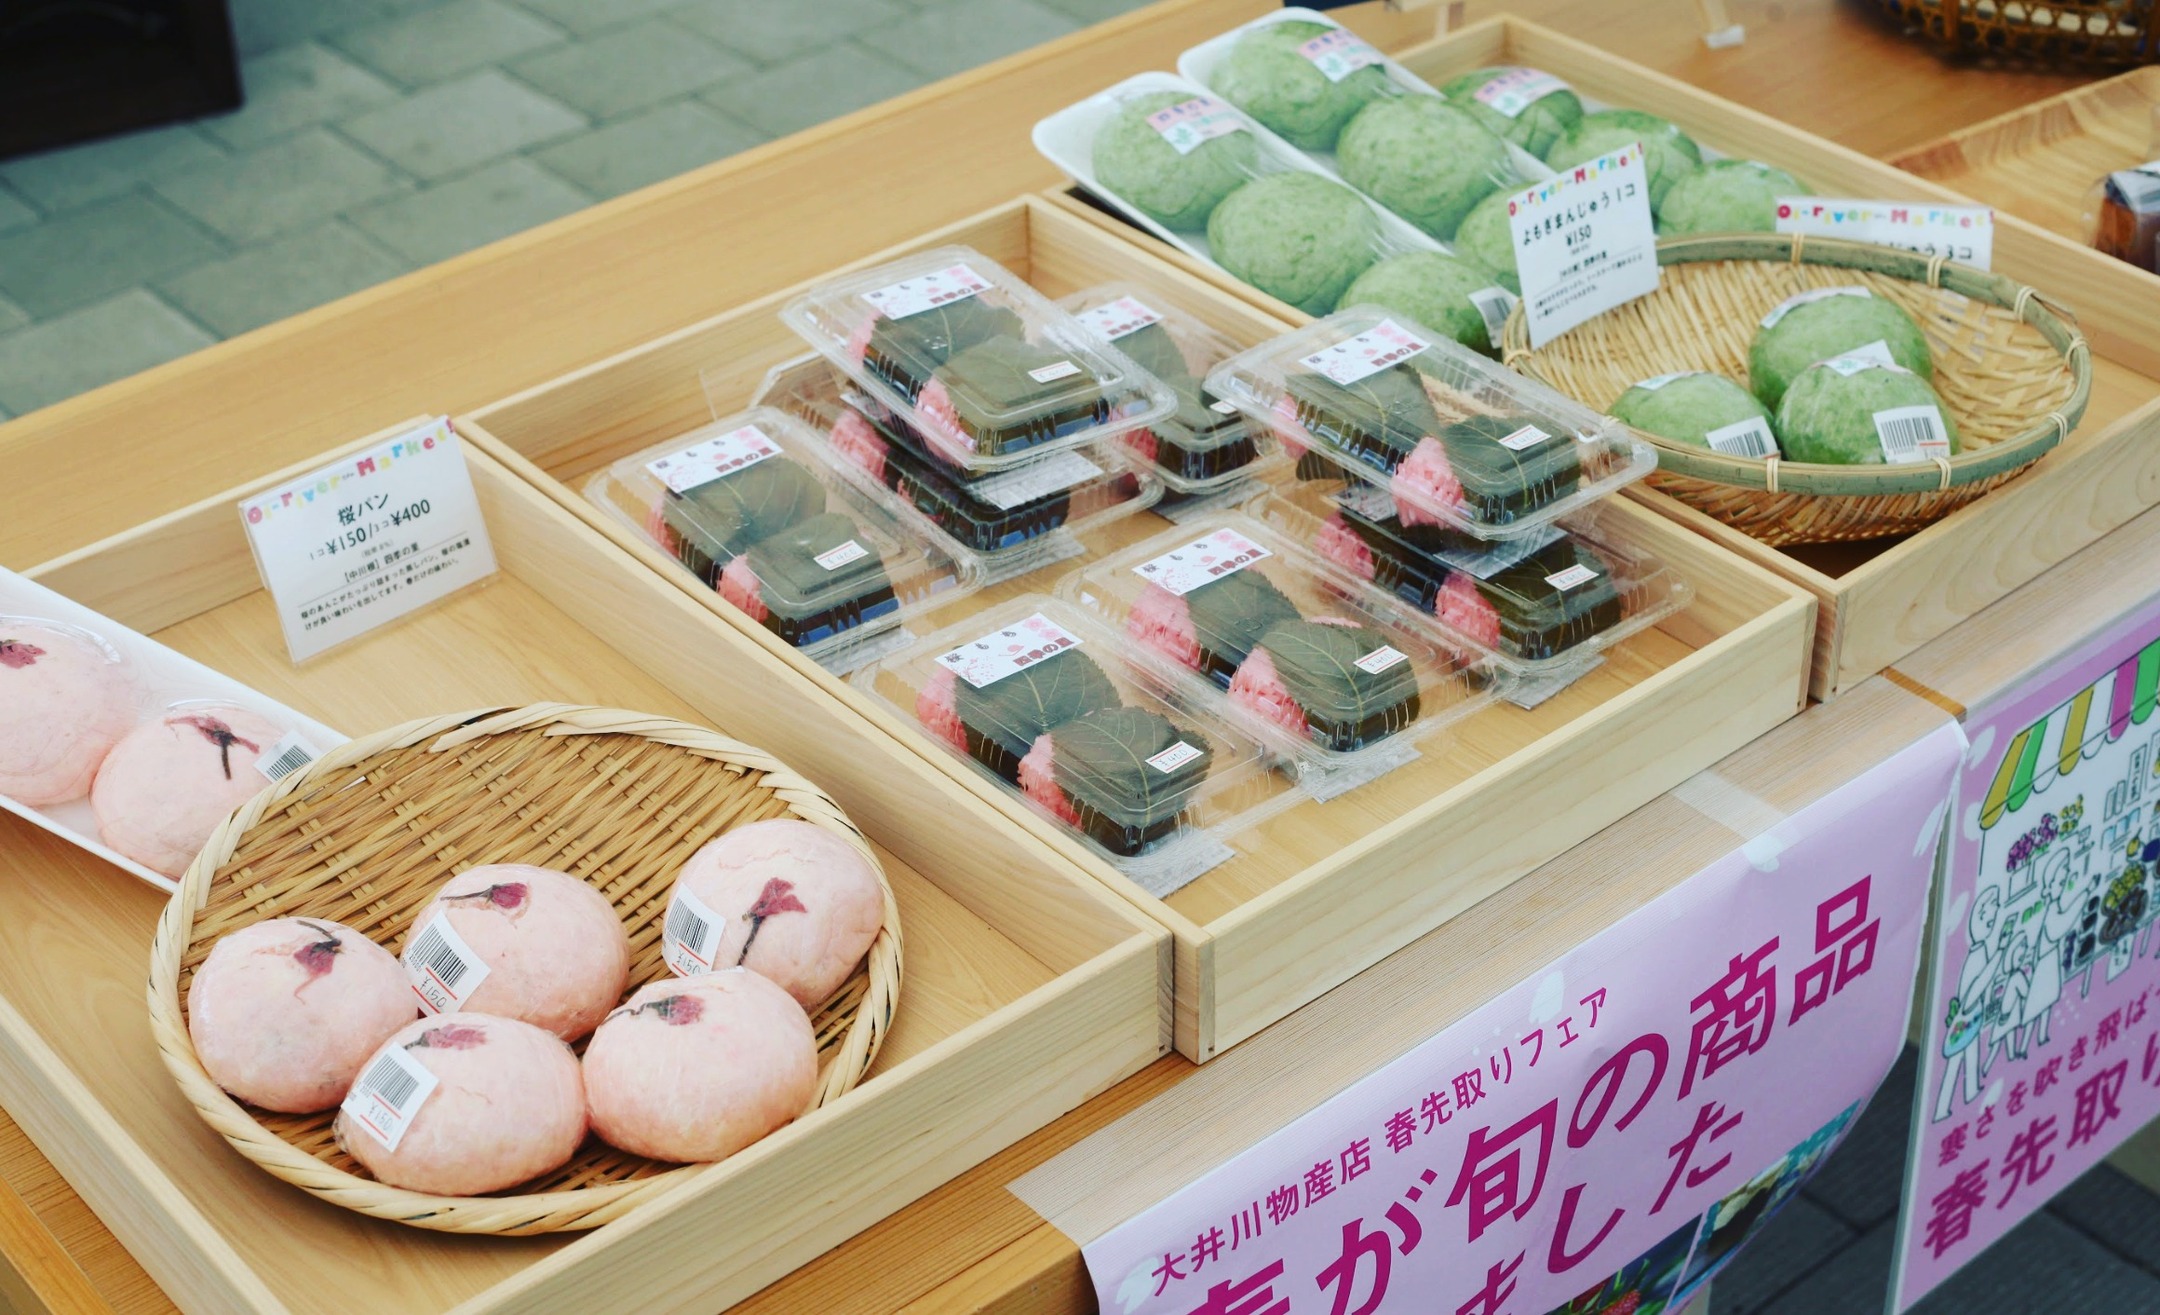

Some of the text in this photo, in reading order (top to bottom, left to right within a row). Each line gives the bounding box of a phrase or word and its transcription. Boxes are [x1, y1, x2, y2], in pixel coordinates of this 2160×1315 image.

[1565, 224, 1592, 246] ¥150
[337, 493, 389, 526] 桜パン
[676, 949, 702, 975] ¥150
[420, 976, 447, 1008] ¥150
[1938, 983, 2160, 1168] 寒さを吹き飛ば
[1151, 987, 1607, 1297] 大井川物産店 春先取りフェア
